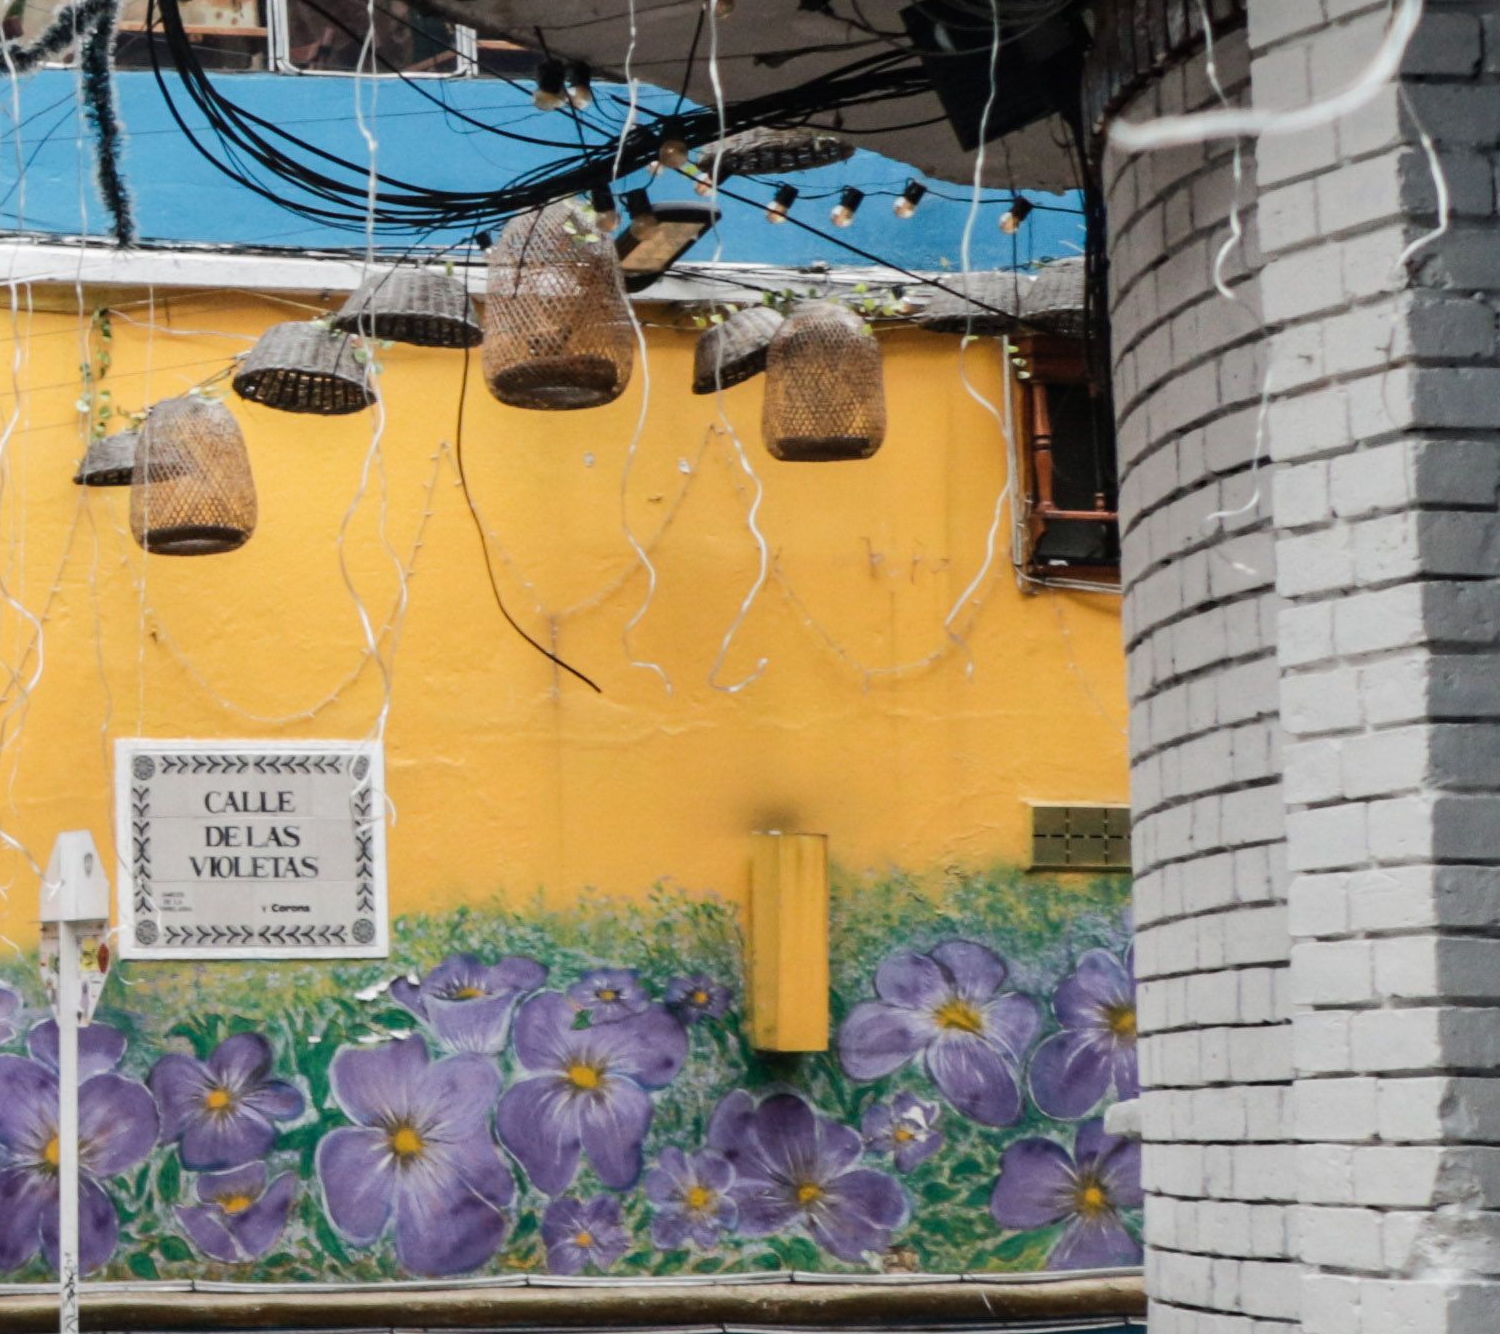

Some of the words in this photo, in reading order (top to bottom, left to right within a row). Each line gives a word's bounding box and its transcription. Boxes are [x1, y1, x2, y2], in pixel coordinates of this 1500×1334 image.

[204, 790, 297, 814] CALLE
[205, 825, 244, 848] DE
[247, 825, 300, 848] LAS
[189, 855, 319, 879] VIOLETAS
[272, 904, 311, 913] Corona
